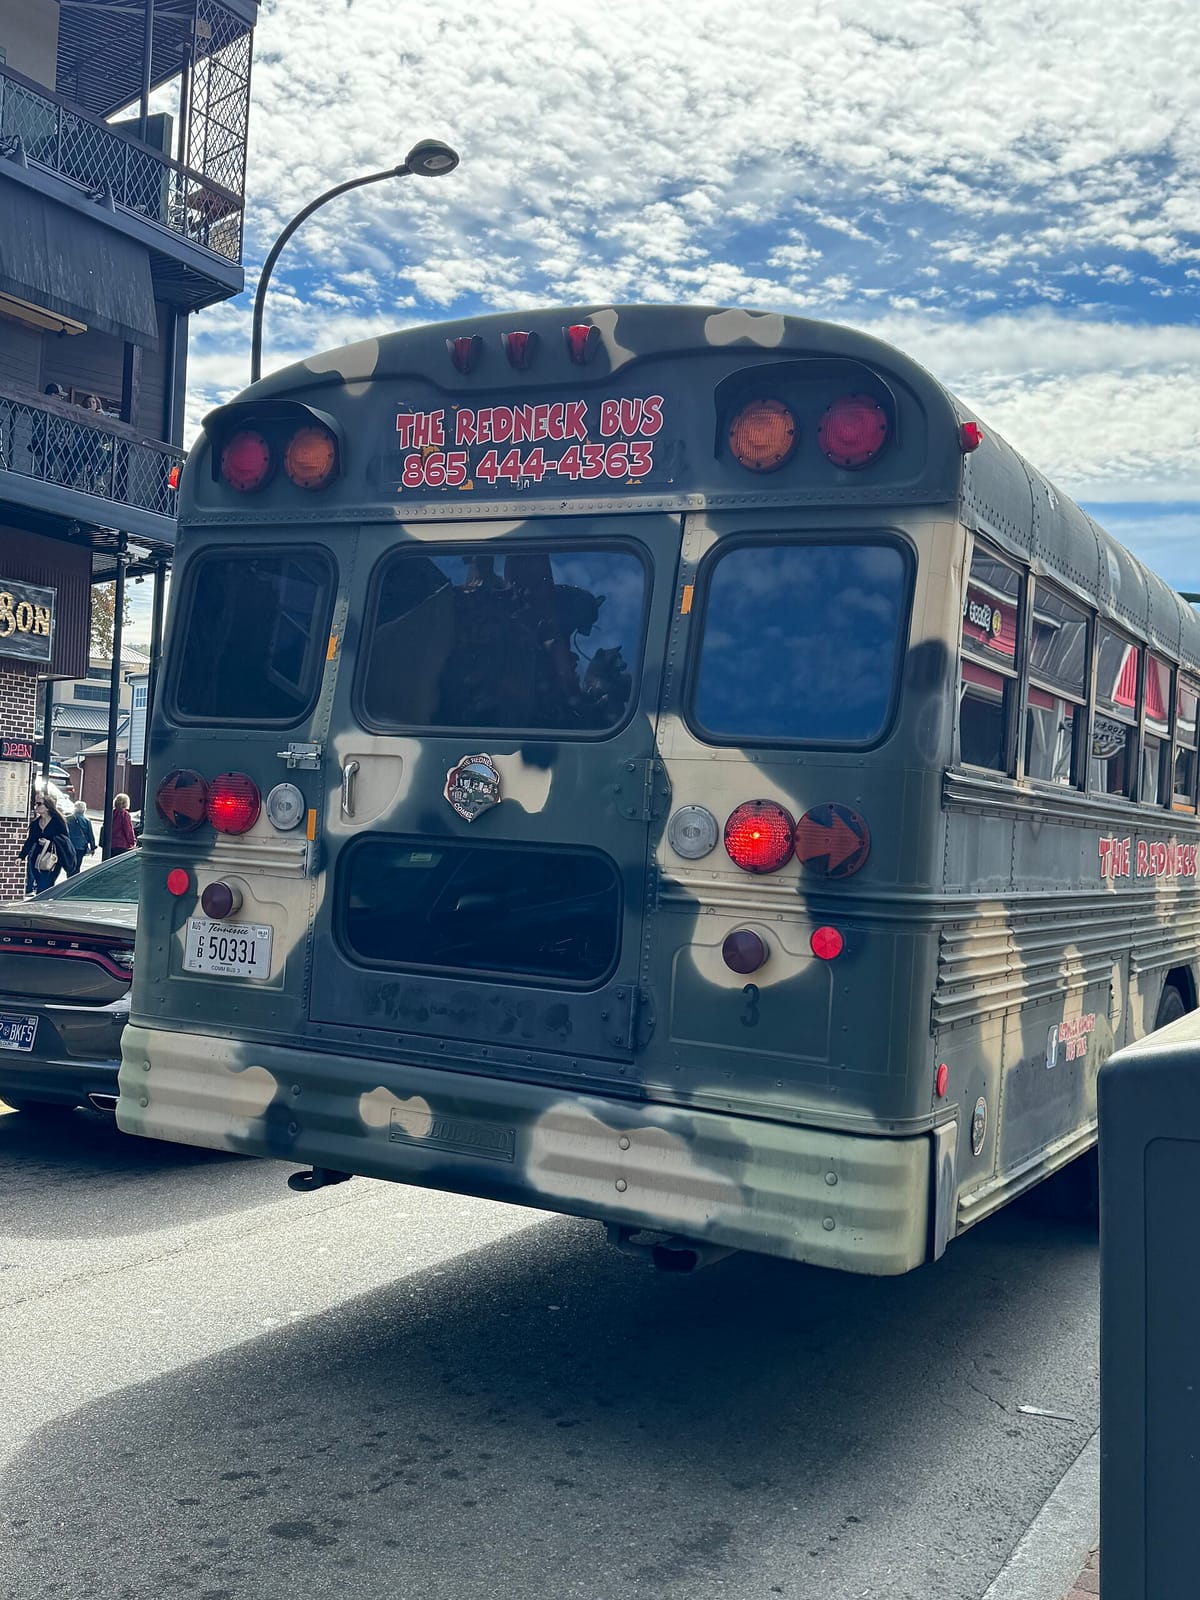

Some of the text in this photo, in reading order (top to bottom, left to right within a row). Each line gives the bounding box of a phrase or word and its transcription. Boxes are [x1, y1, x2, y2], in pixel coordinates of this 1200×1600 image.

[396, 395, 664, 450] THE REDNECK BUS
[402, 441, 653, 488] 865 444-4363
[2, 742, 32, 758] OPEN
[1099, 837, 1198, 880] THE REDNECK
[208, 922, 249, 935] Tennessee
[208, 936, 257, 965] 50331
[740, 983, 760, 1028] 3
